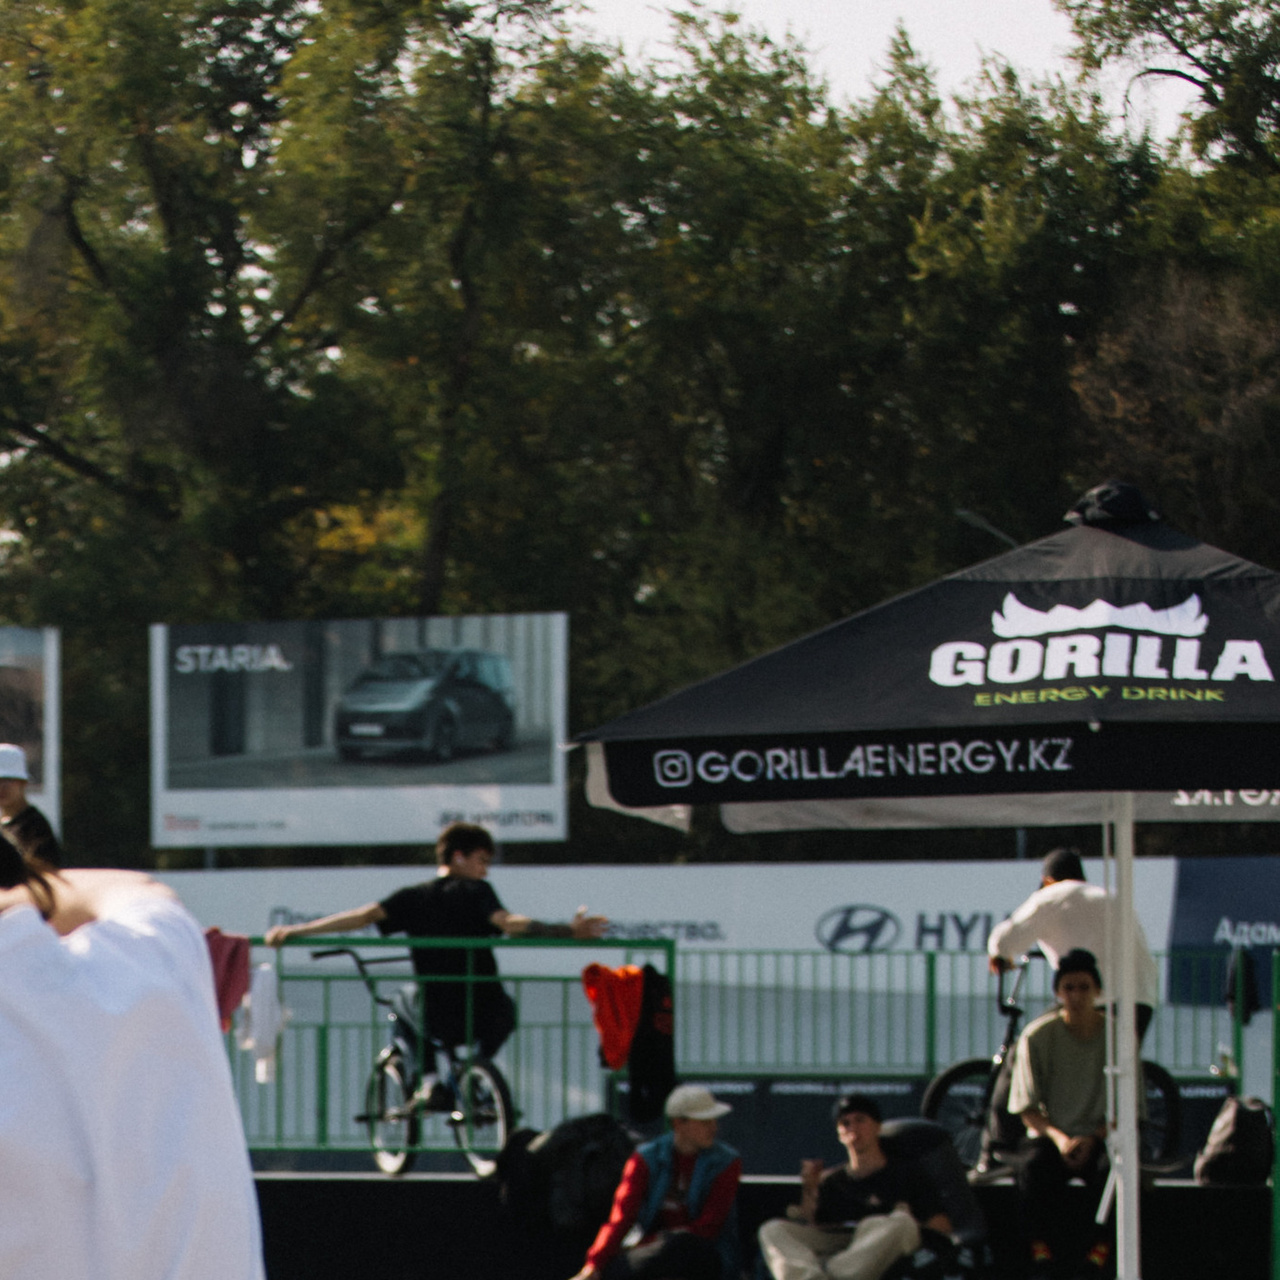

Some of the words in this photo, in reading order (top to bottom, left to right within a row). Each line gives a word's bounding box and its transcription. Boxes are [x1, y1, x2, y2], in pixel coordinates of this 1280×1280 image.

[175, 645, 293, 674] STARIA.
[929, 633, 1275, 687] GORILLA
[974, 686, 1110, 706] ENERGY
[1122, 686, 1225, 702] DRINK
